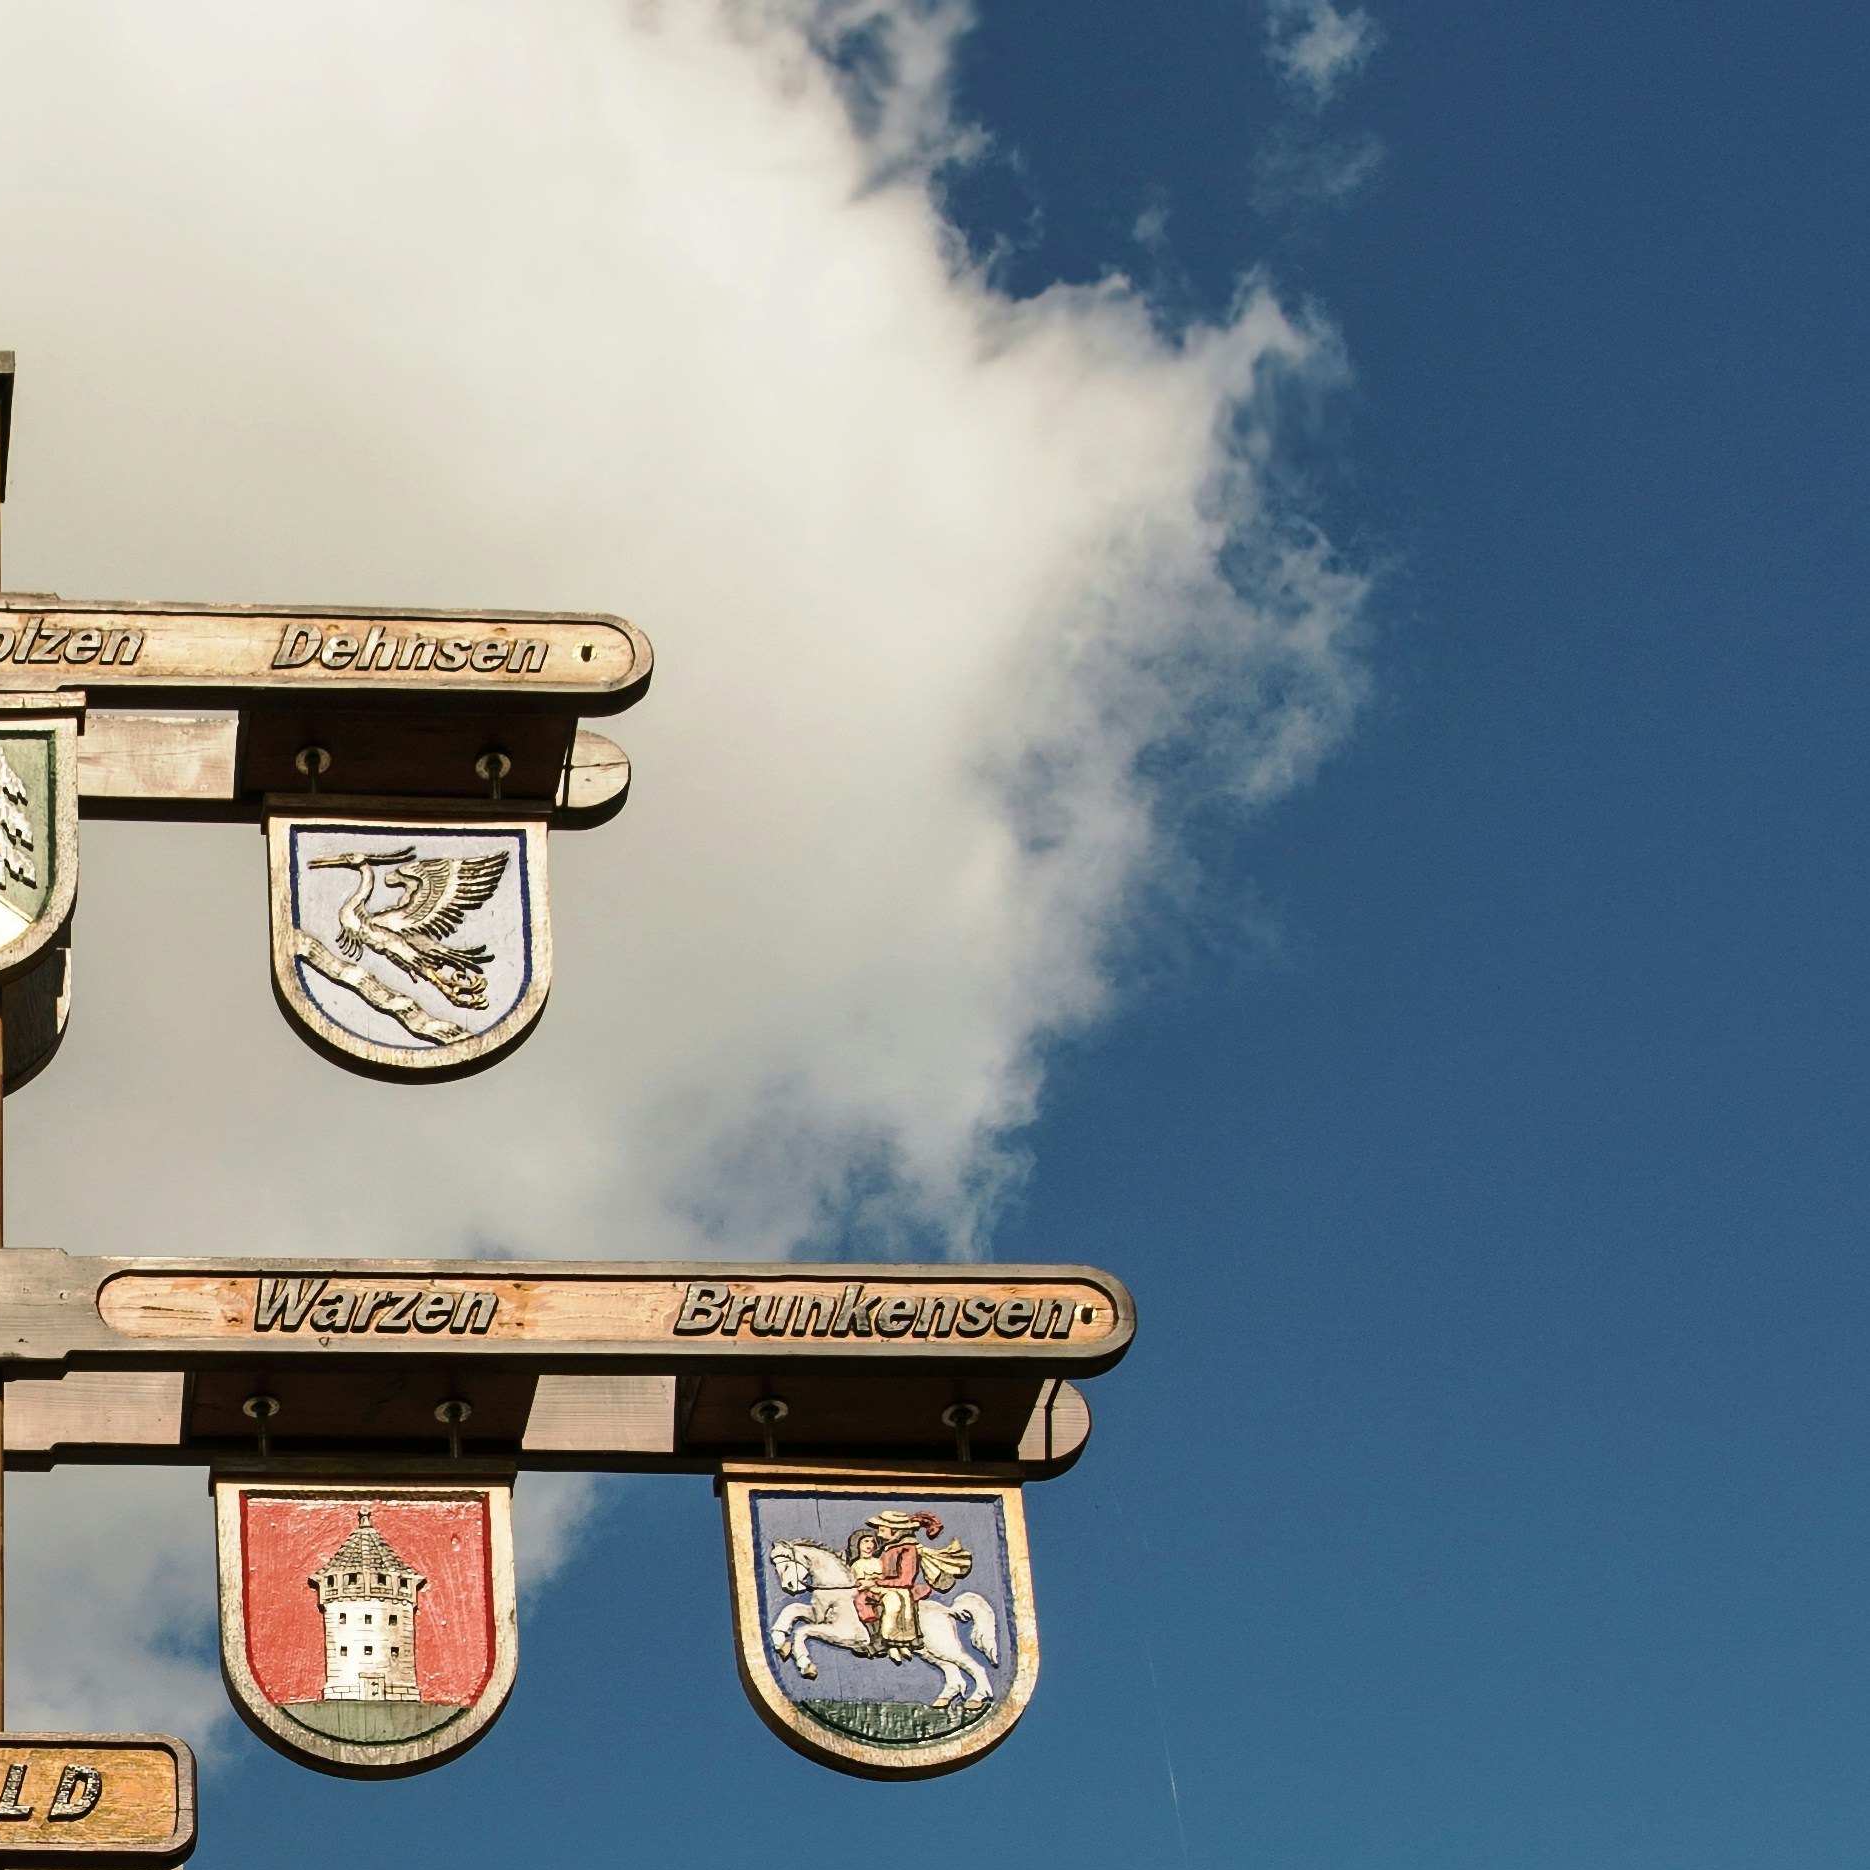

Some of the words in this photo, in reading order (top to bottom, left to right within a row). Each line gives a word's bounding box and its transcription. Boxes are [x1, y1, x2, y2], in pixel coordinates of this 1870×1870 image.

[272, 621, 550, 673] Dehnsen
[253, 1277, 499, 1334] Warzen
[673, 1282, 1076, 1339] Brunkensen
